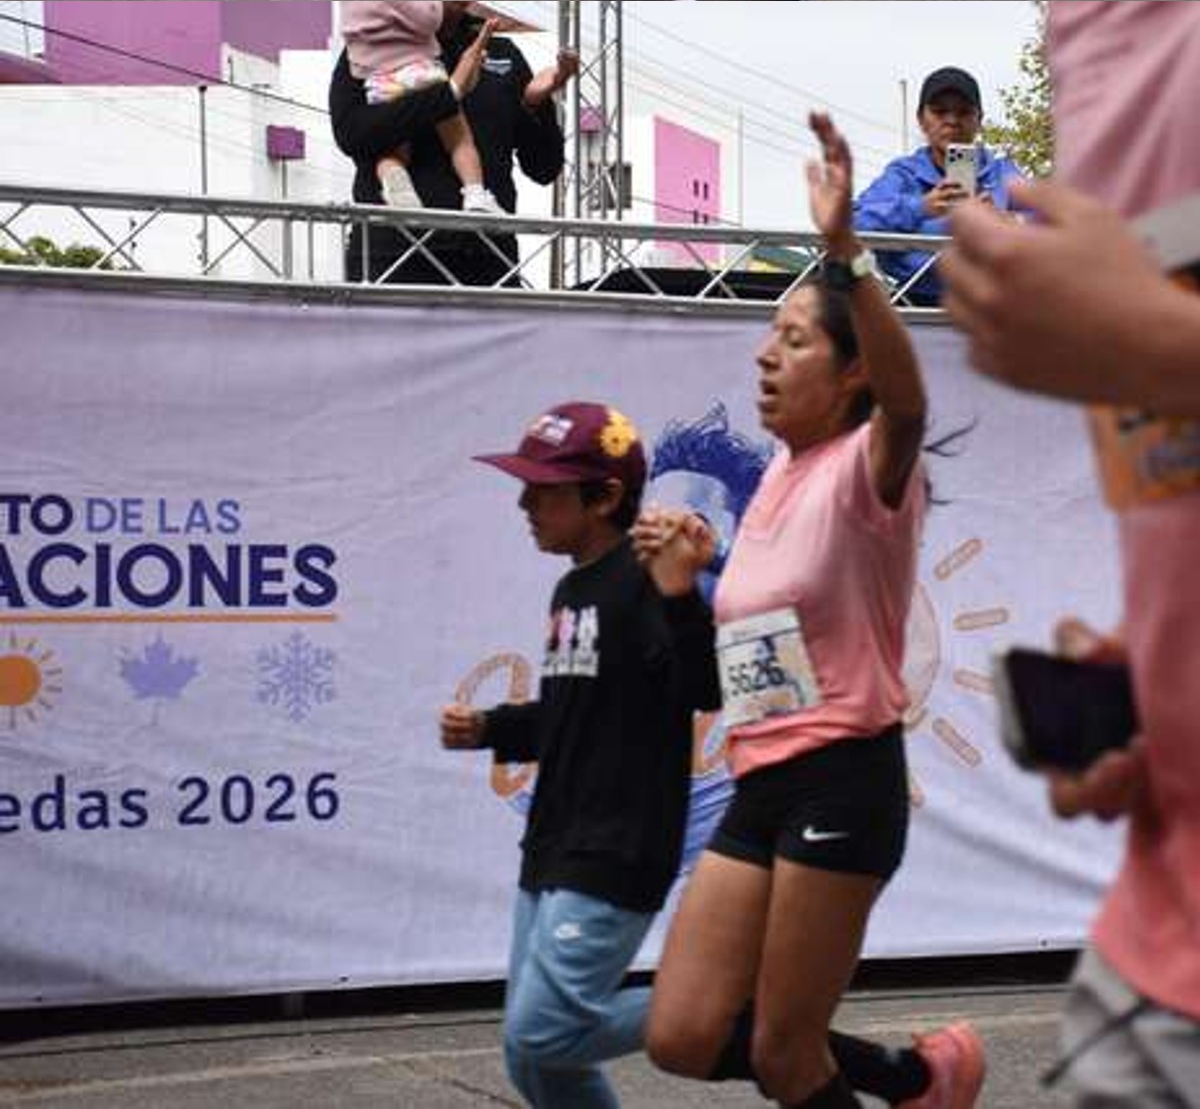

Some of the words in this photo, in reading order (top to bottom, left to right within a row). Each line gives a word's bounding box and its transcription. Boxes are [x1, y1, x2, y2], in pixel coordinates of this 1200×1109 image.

[86, 497, 143, 533] DE
[158, 498, 241, 534] LAS
[177, 772, 339, 825] 2026
